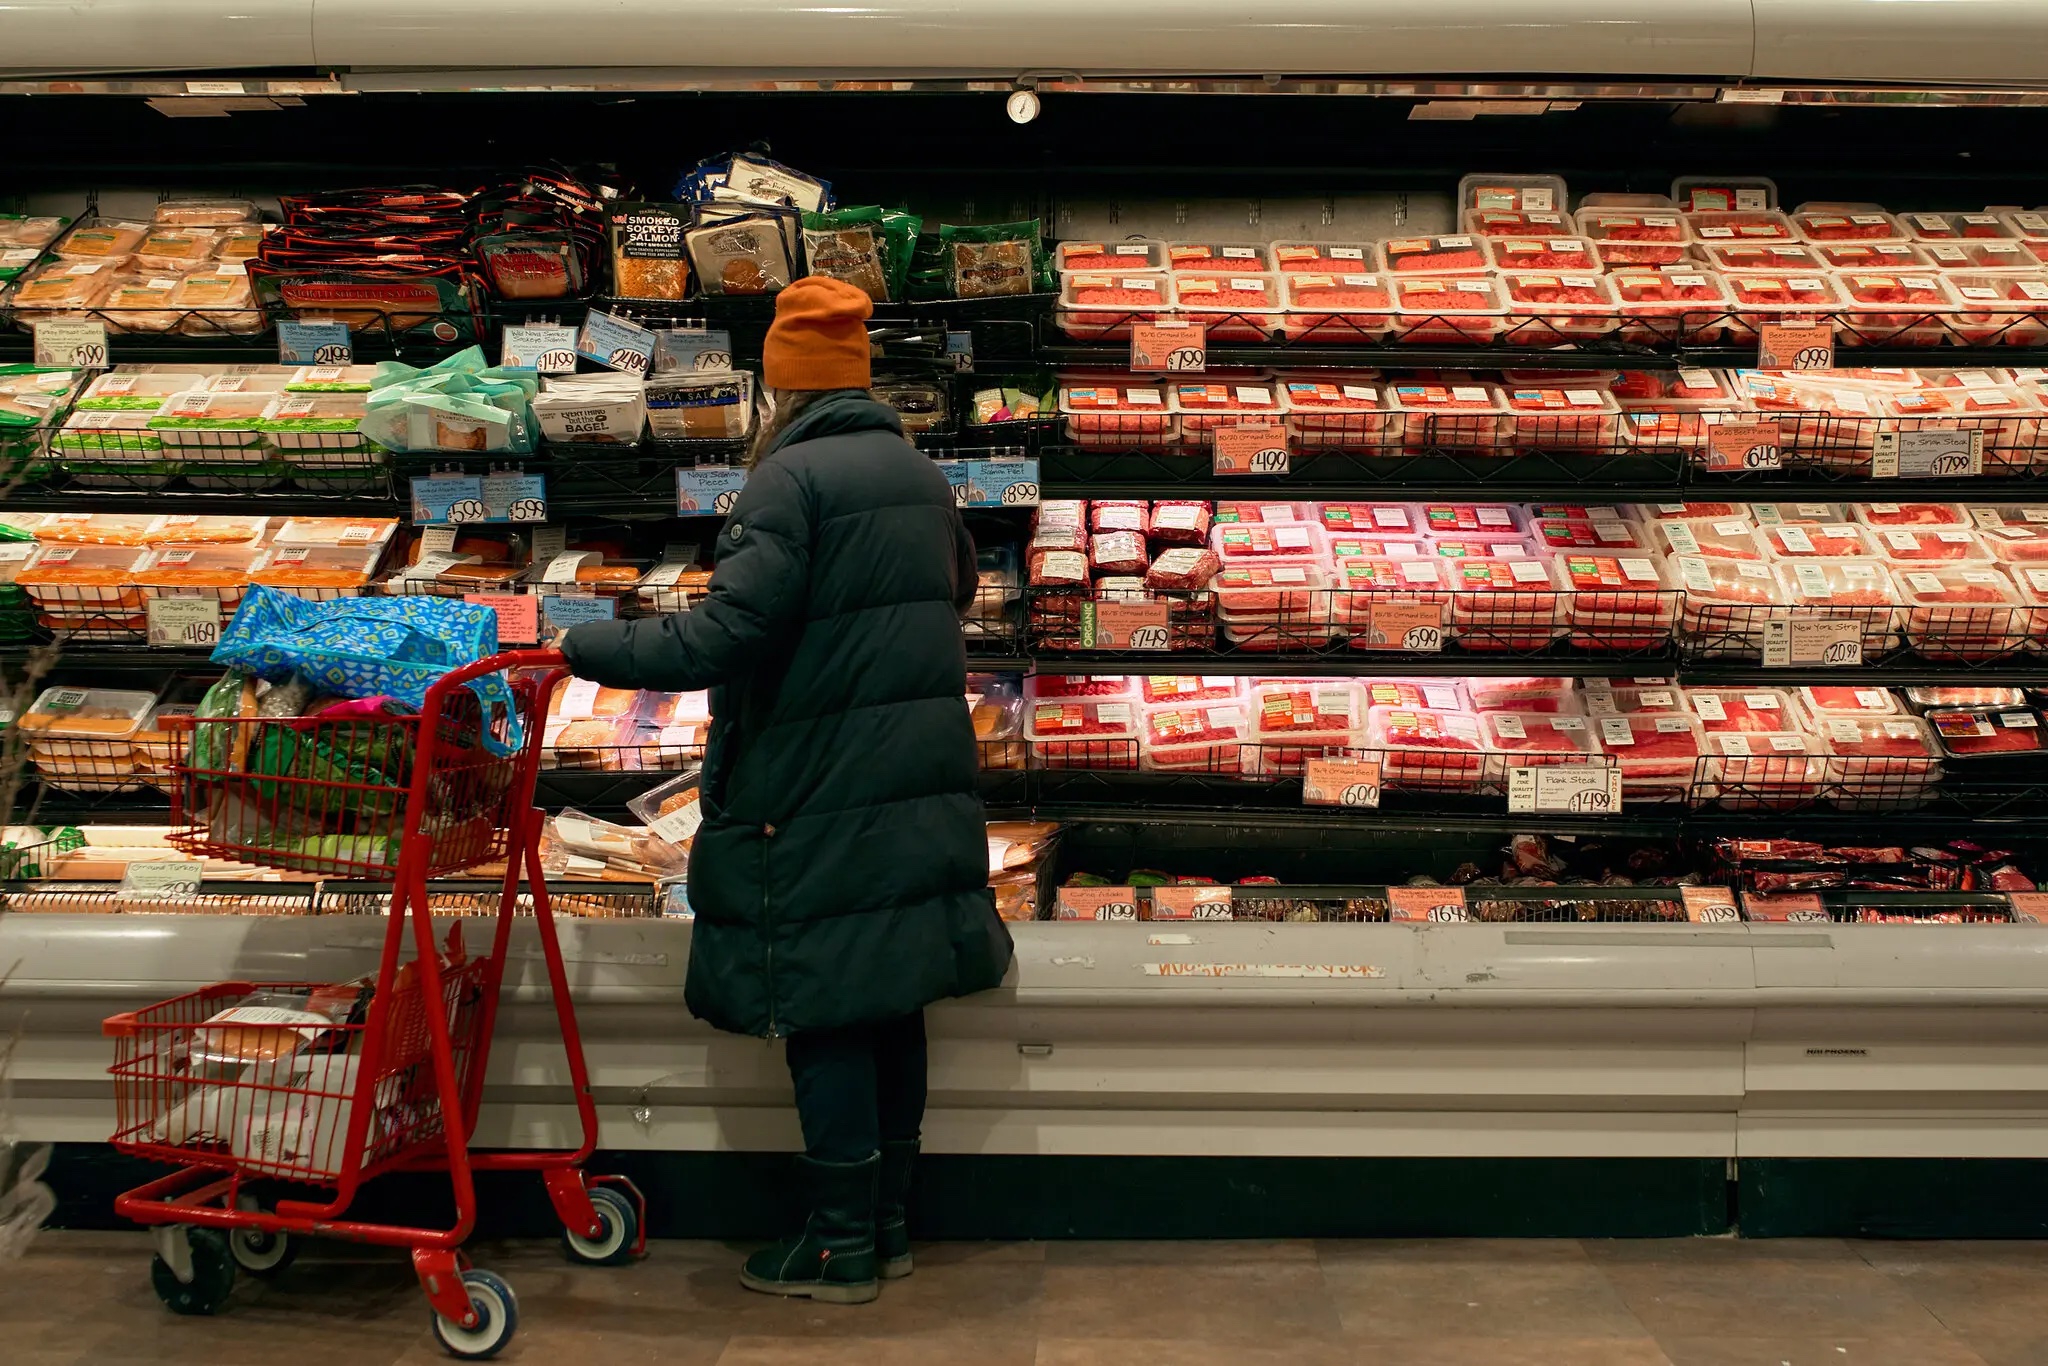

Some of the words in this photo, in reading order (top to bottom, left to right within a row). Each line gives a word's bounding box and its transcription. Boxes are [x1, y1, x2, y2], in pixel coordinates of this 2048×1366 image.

[629, 216, 680, 226] SMOKED
[627, 225, 681, 234] SOCKEYE
[630, 234, 678, 243] SALMON
[687, 388, 738, 401] SALON
[581, 416, 594, 424] the
[565, 422, 610, 433] BAGEL
[1902, 439, 1916, 447] Top
[1944, 438, 1967, 446] Steak
[710, 471, 740, 479] Salmon
[1084, 603, 1093, 647] ORGANIC
[1814, 624, 1834, 632] York
[1835, 623, 1858, 632] Strip
[1546, 776, 1567, 784] Flank
[1570, 776, 1597, 784] Steak
[168, 863, 200, 872] Turkey
